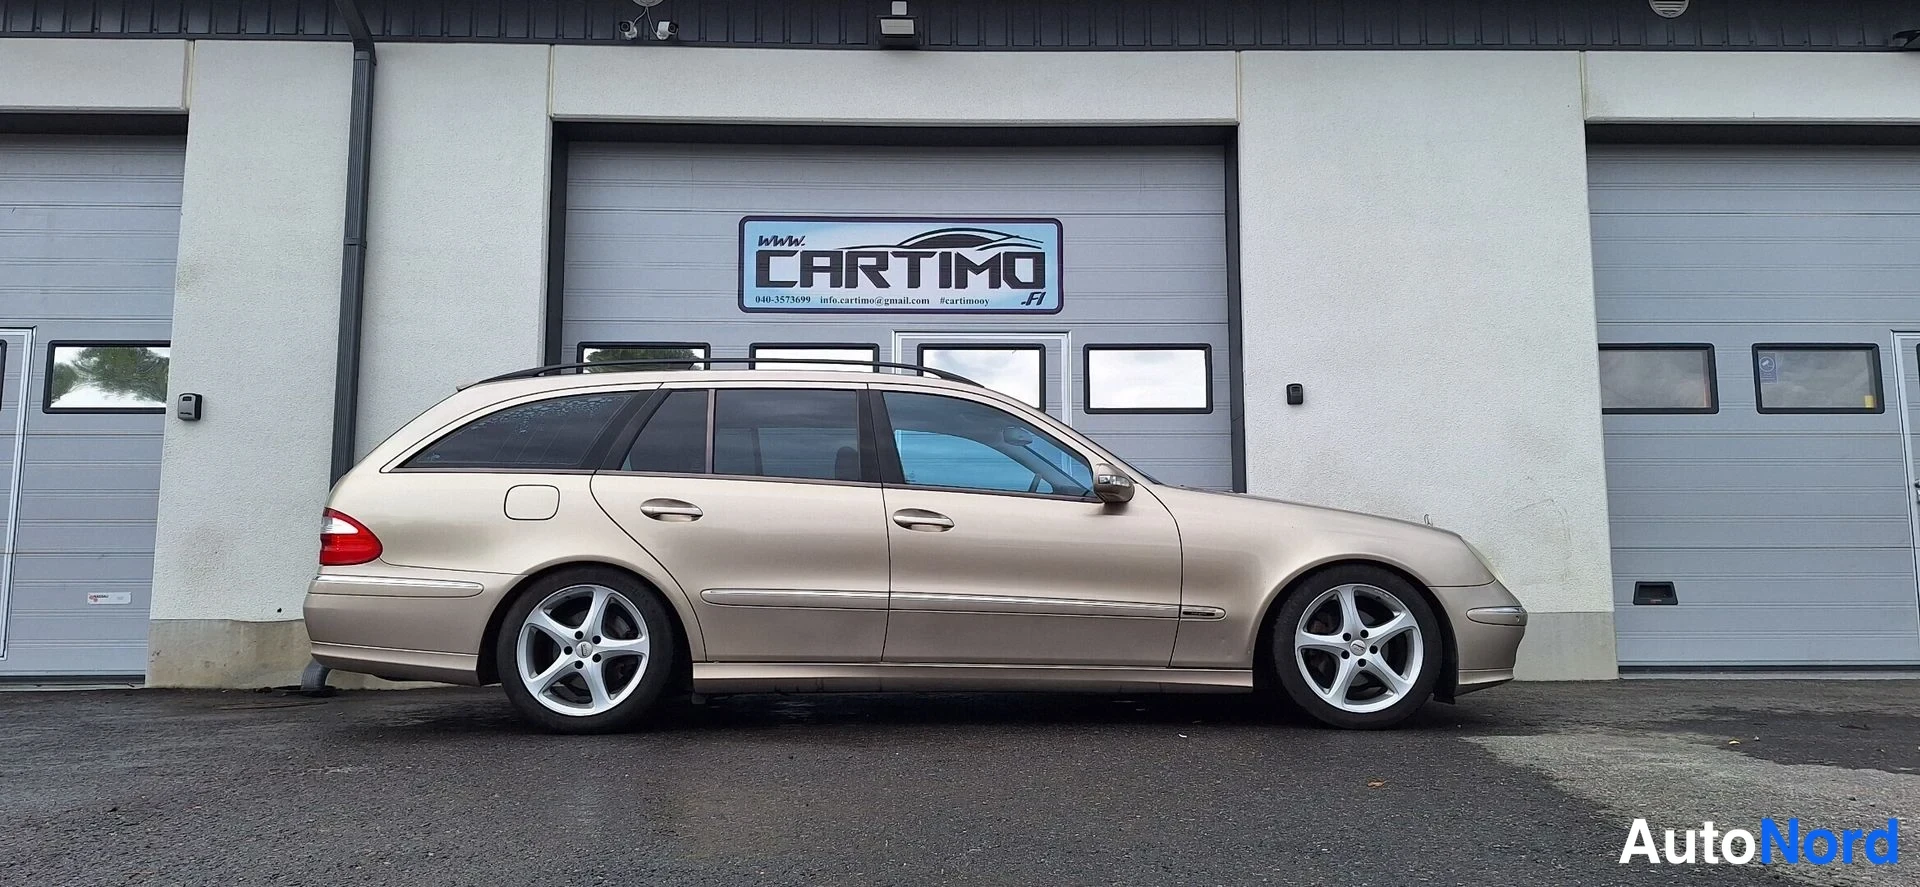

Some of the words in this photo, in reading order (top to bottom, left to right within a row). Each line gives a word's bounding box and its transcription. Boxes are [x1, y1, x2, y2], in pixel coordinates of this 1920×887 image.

[755, 250, 1045, 290] CARTIMO
[755, 295, 811, 304] 040-3573699
[820, 296, 930, 306] info.cartimo@gmail.com
[939, 296, 990, 307] #cartimooy
